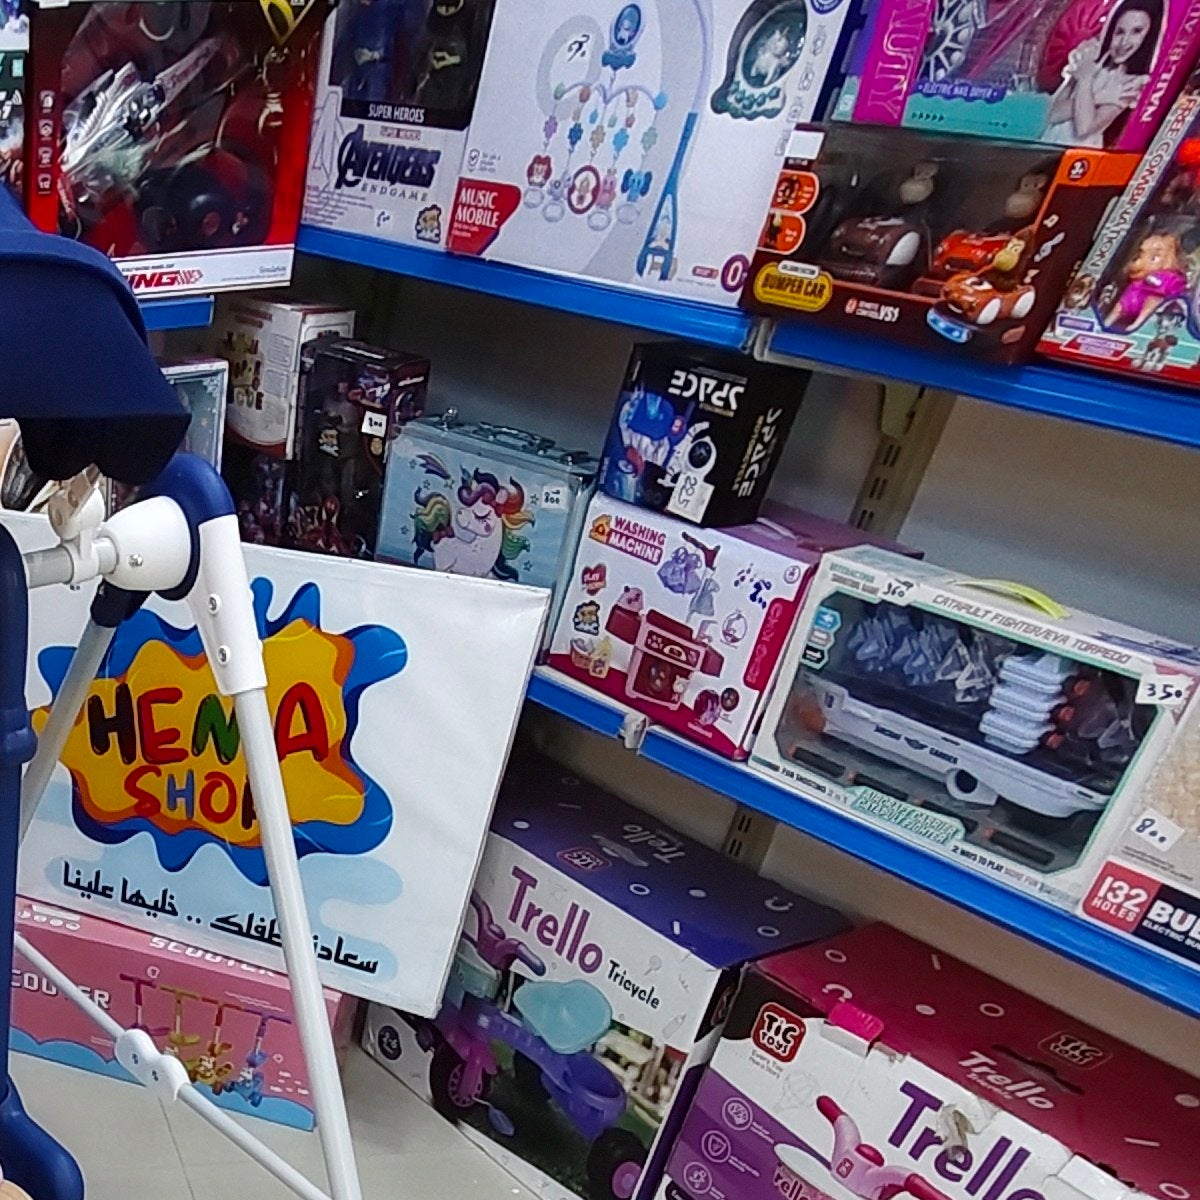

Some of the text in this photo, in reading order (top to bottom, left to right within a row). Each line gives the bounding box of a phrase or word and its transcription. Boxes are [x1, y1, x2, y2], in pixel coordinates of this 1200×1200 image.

[1141, 62, 1175, 121] NAIL
[368, 103, 425, 123] SUPER HEROES
[361, 183, 429, 202] ENDGAME
[458, 187, 499, 209] MUSIC
[455, 205, 500, 228] MOBILE
[761, 274, 827, 298] BUMPER CAR
[668, 369, 745, 411] SPACE
[614, 515, 667, 546] WASHING
[609, 531, 663, 563] MACHINE
[932, 593, 1132, 664] CATAPULT FIGHTER/EVA TORPEDO
[902, 815, 950, 845] FIGHTER
[912, 808, 959, 838] CARRIER
[63, 860, 114, 899] علينا
[987, 859, 1005, 872] PLAY
[120, 876, 179, 918] خليها
[1091, 897, 1137, 922] HOLES
[1097, 875, 1148, 913] 132
[508, 865, 603, 974] Trello
[1142, 919, 1185, 942] ELECTRIC
[606, 959, 660, 1010] Tricycle
[958, 1051, 1055, 1109] Trello
